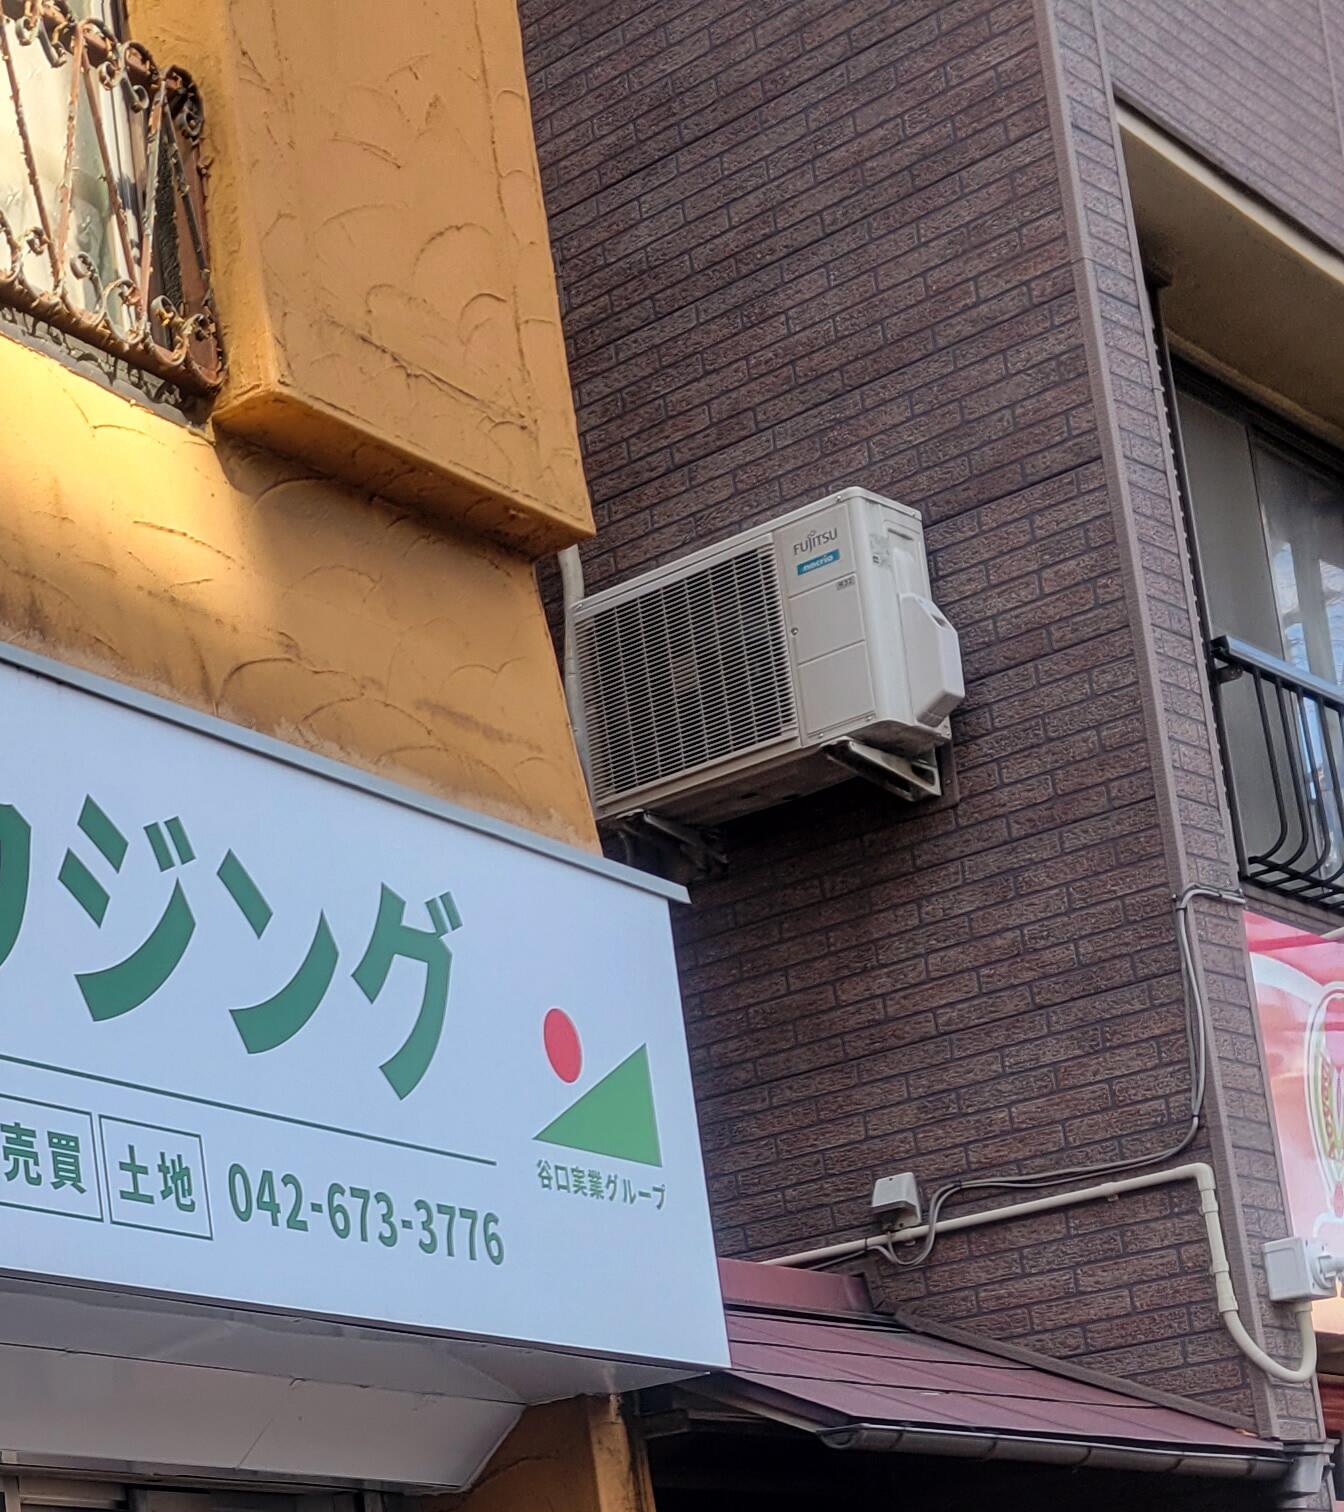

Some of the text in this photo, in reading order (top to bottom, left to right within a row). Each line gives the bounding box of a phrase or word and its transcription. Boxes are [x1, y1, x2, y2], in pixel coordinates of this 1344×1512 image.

[793, 528, 838, 555] FUJITSU
[0, 1122, 88, 1194] 売買
[118, 1144, 197, 1213] 土地
[227, 1163, 505, 1266] 042-673-3776
[536, 1159, 667, 1211] 谷口実業グループ
